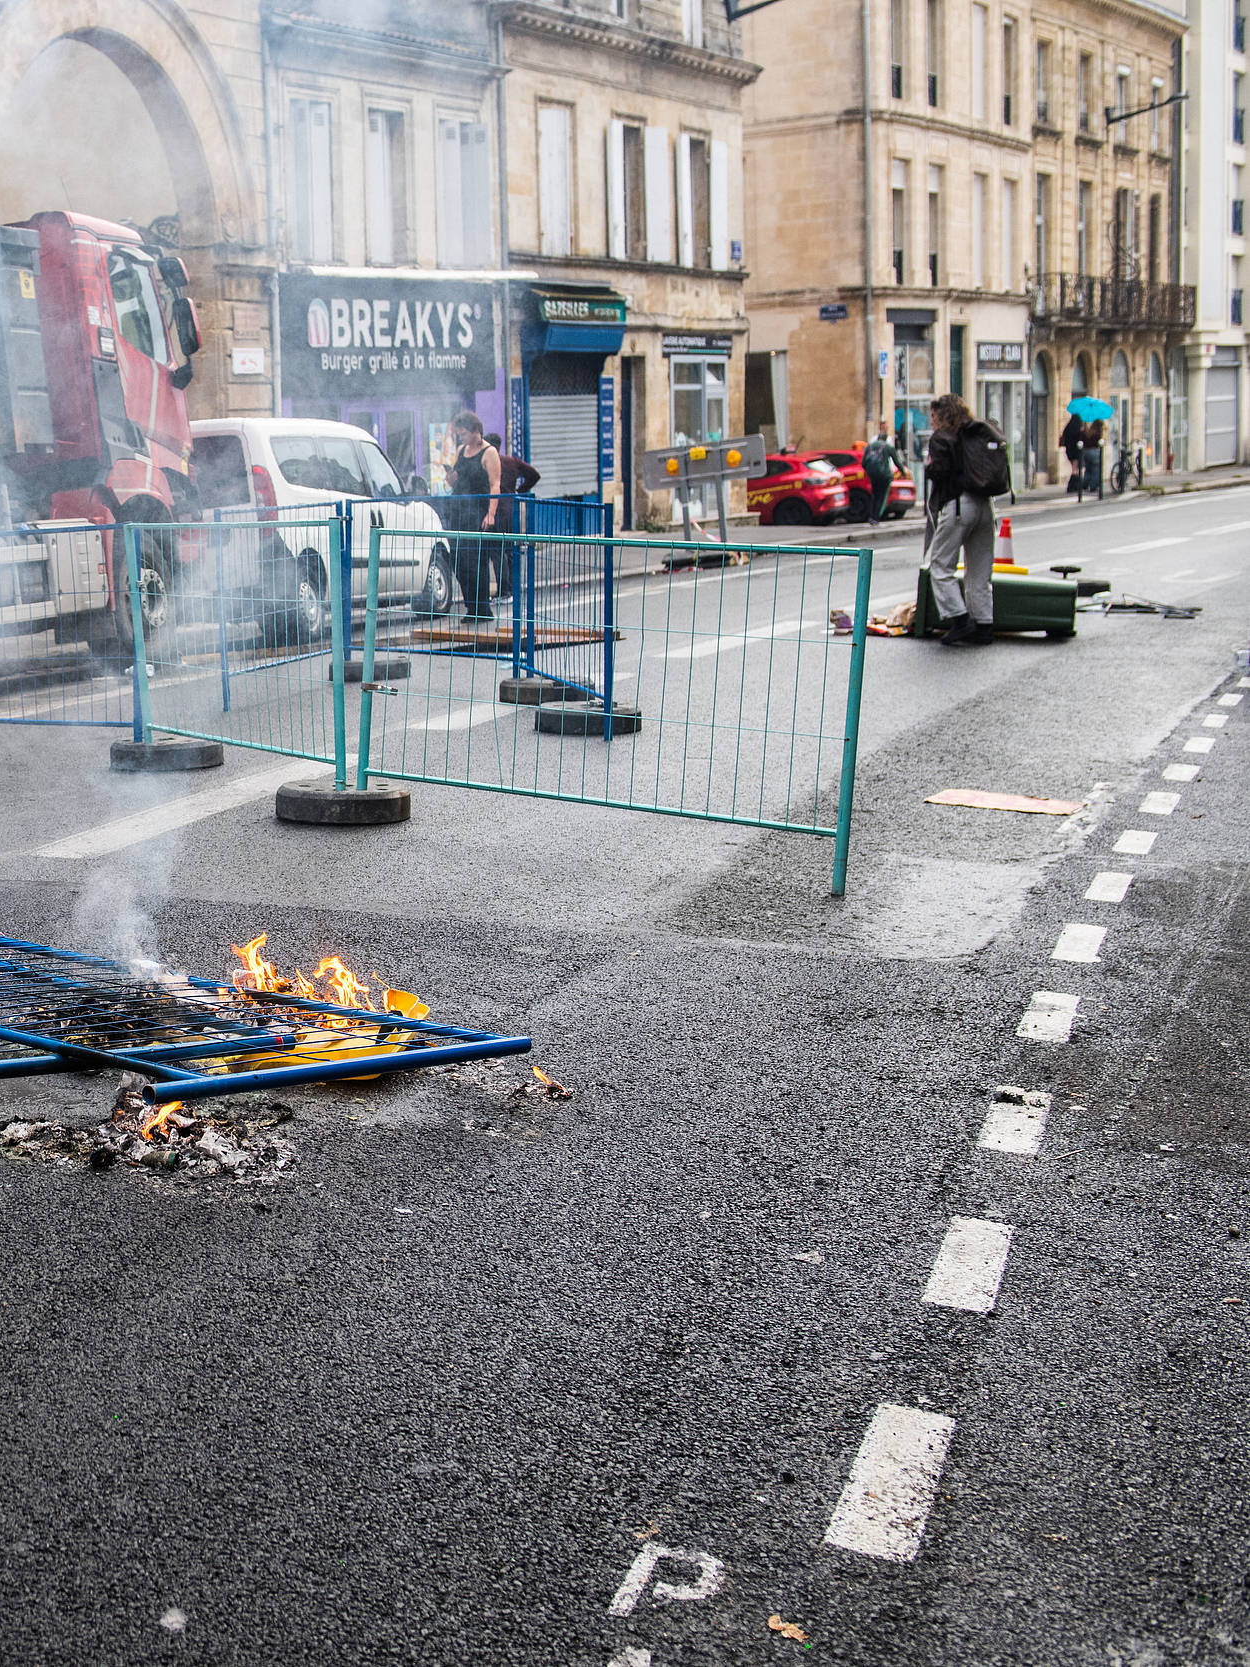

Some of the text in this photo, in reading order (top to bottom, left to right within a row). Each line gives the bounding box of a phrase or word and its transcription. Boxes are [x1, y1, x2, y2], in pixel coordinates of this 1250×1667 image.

[330, 298, 474, 349] BREAKYS
[321, 351, 467, 375] Burger grillé à la flamme
